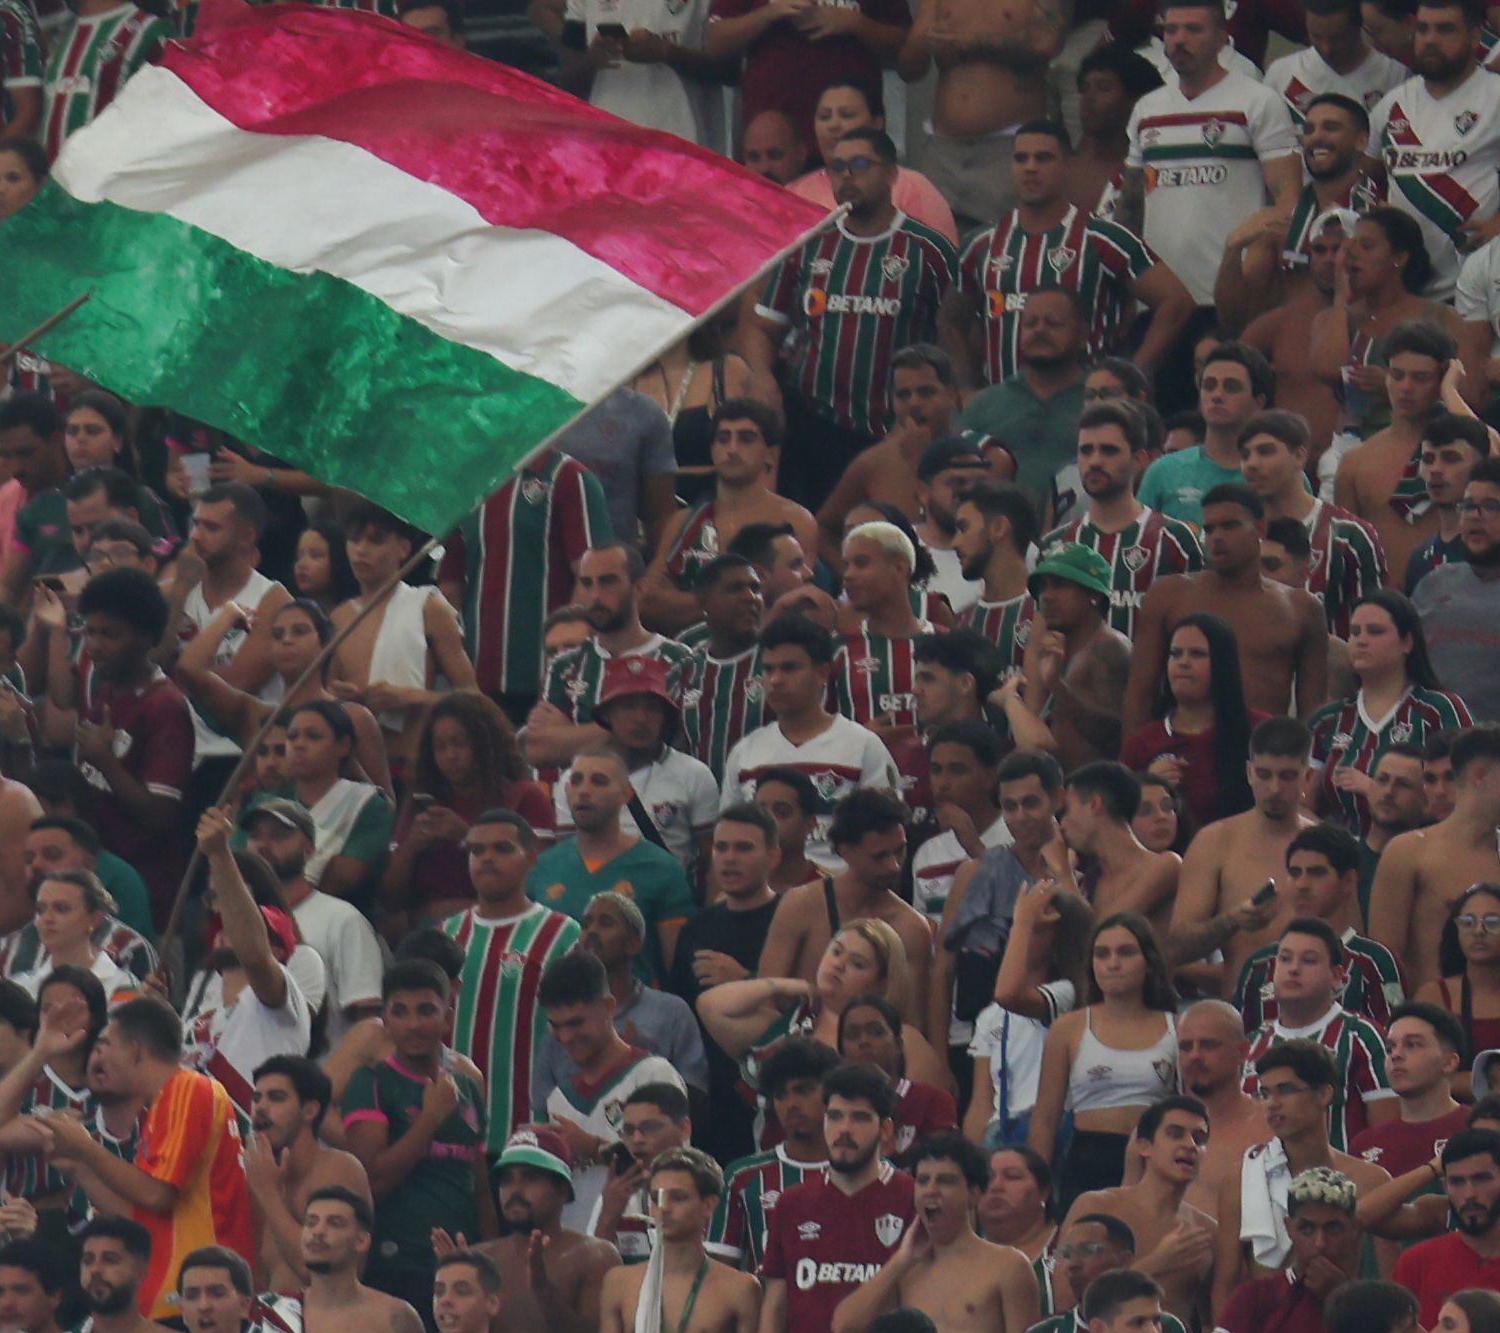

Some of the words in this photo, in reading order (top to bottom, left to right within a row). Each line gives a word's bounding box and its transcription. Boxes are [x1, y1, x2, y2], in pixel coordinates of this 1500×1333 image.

[1397, 146, 1468, 174] BETANO
[1160, 163, 1228, 189] BETANO
[827, 293, 900, 316] BETANO
